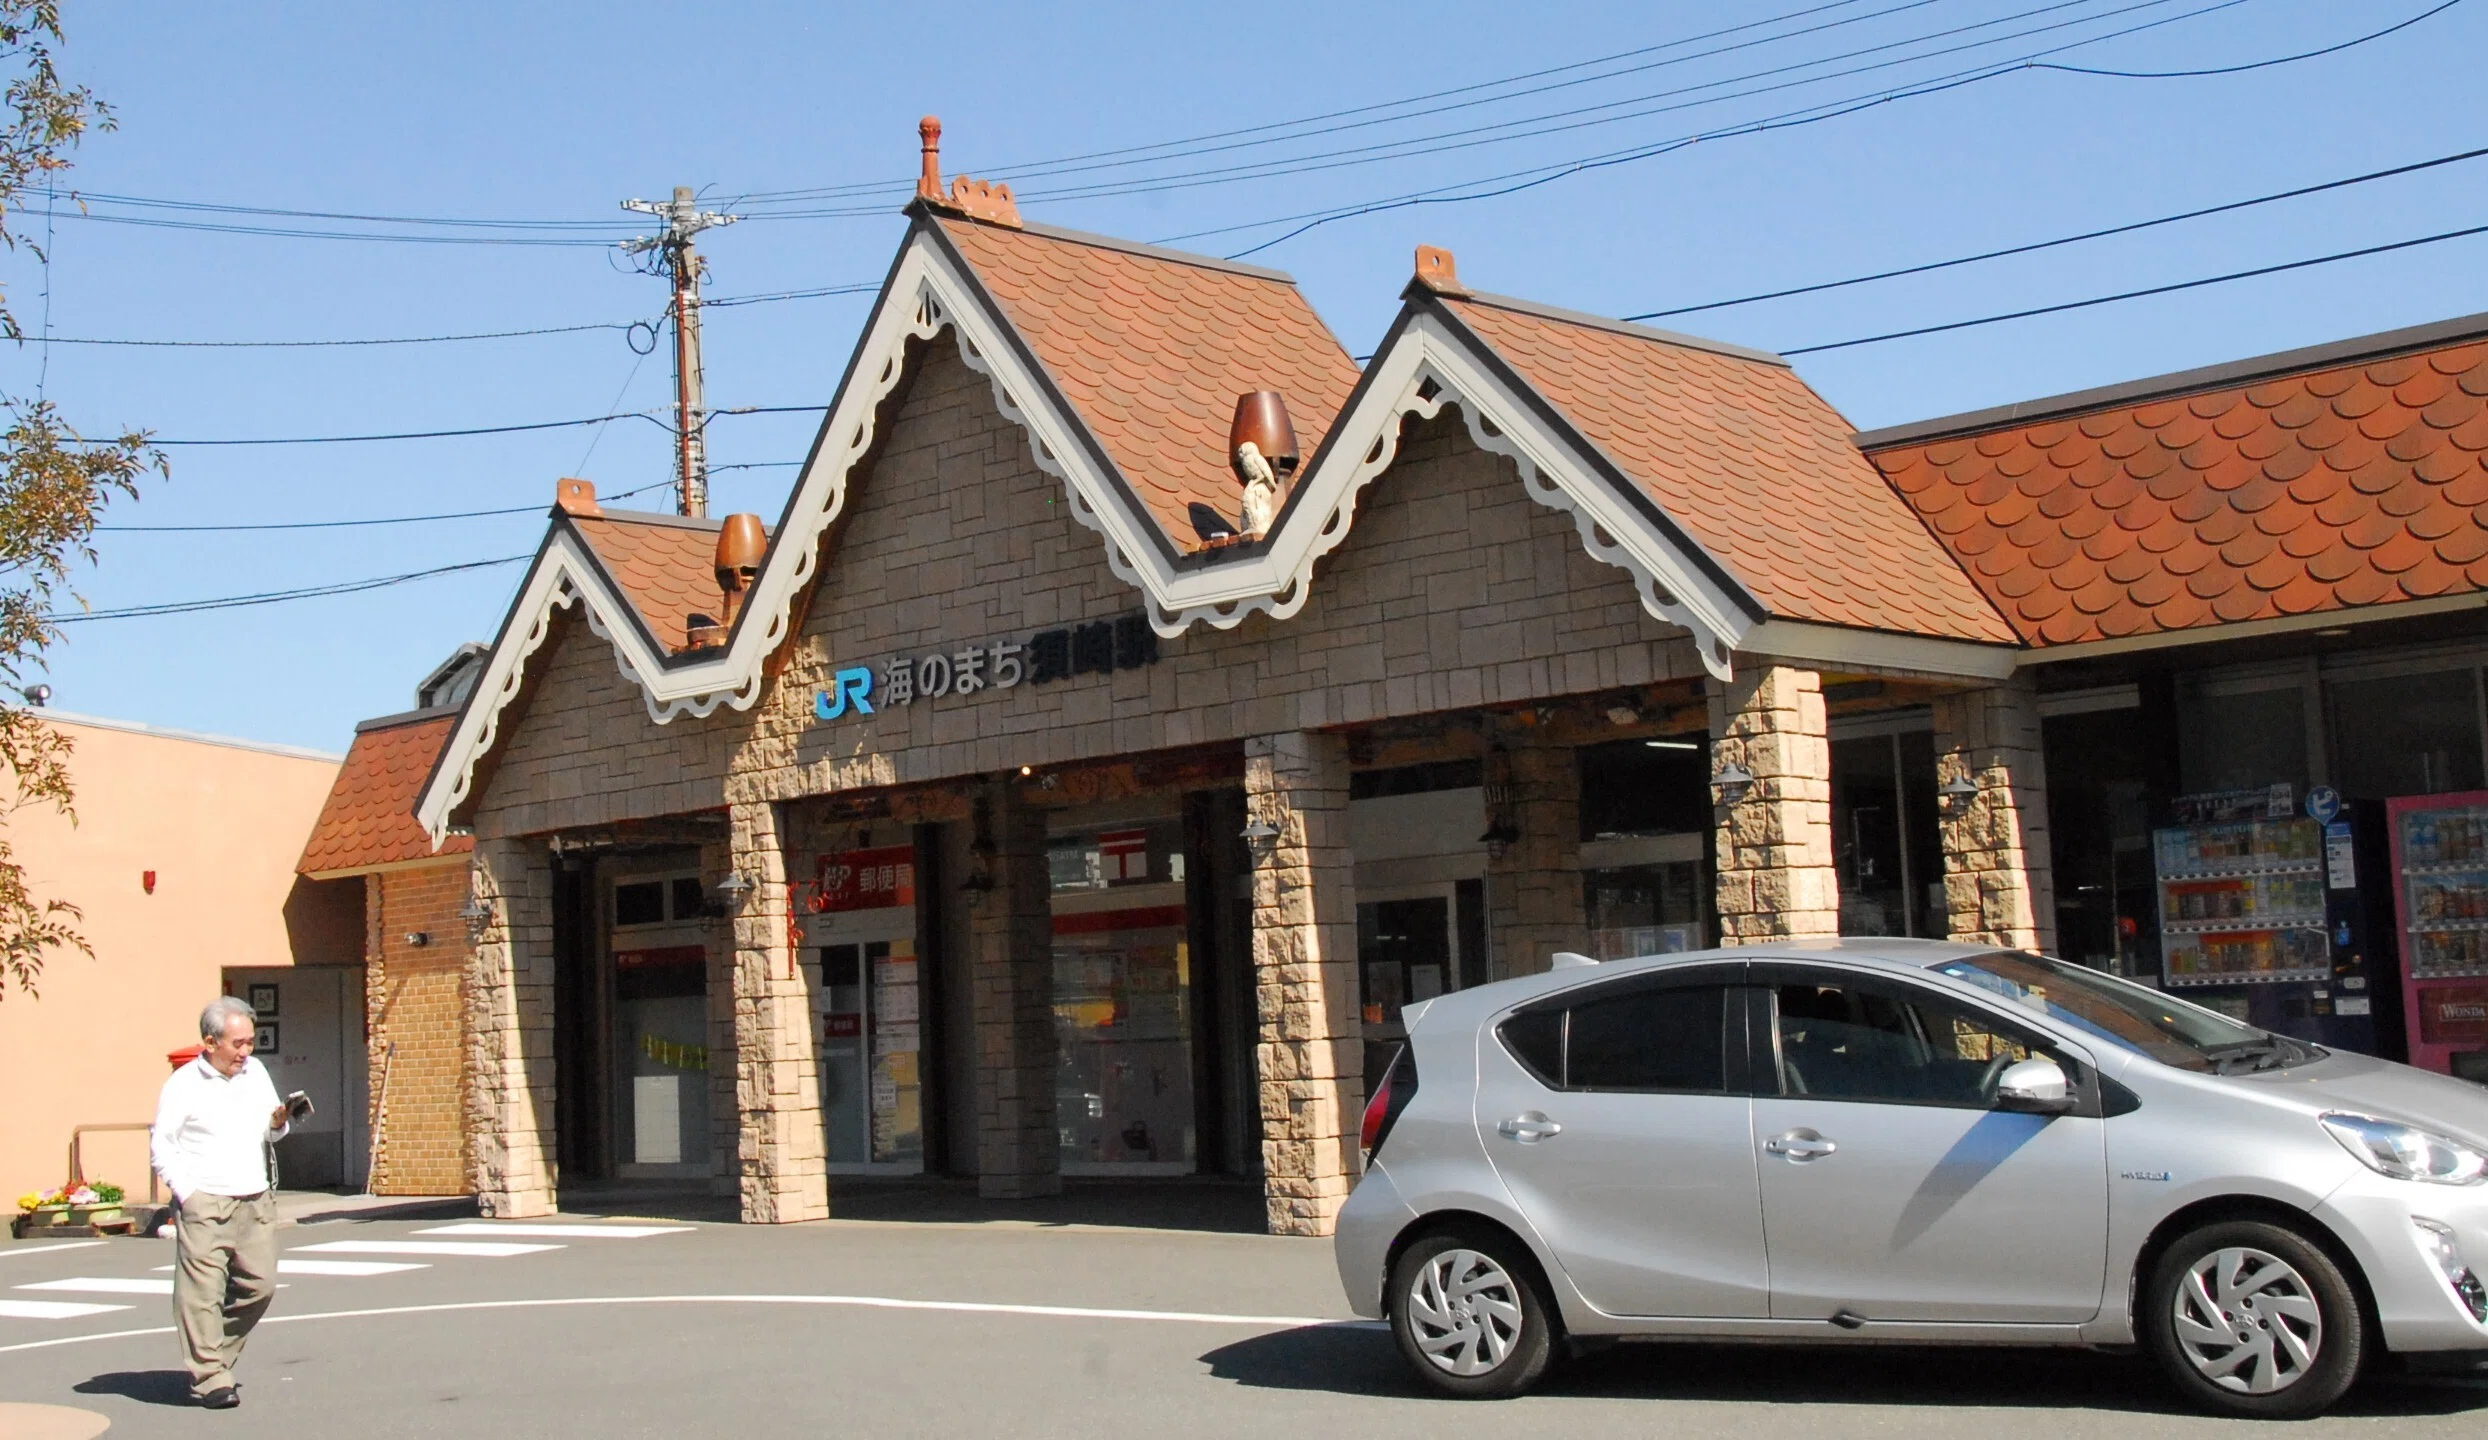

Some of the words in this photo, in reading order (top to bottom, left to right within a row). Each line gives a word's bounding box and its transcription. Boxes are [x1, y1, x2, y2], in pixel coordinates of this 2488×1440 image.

[815, 666, 875, 720] JR
[859, 864, 913, 893] 郵便局
[2440, 1004, 2485, 1018] WONDA
